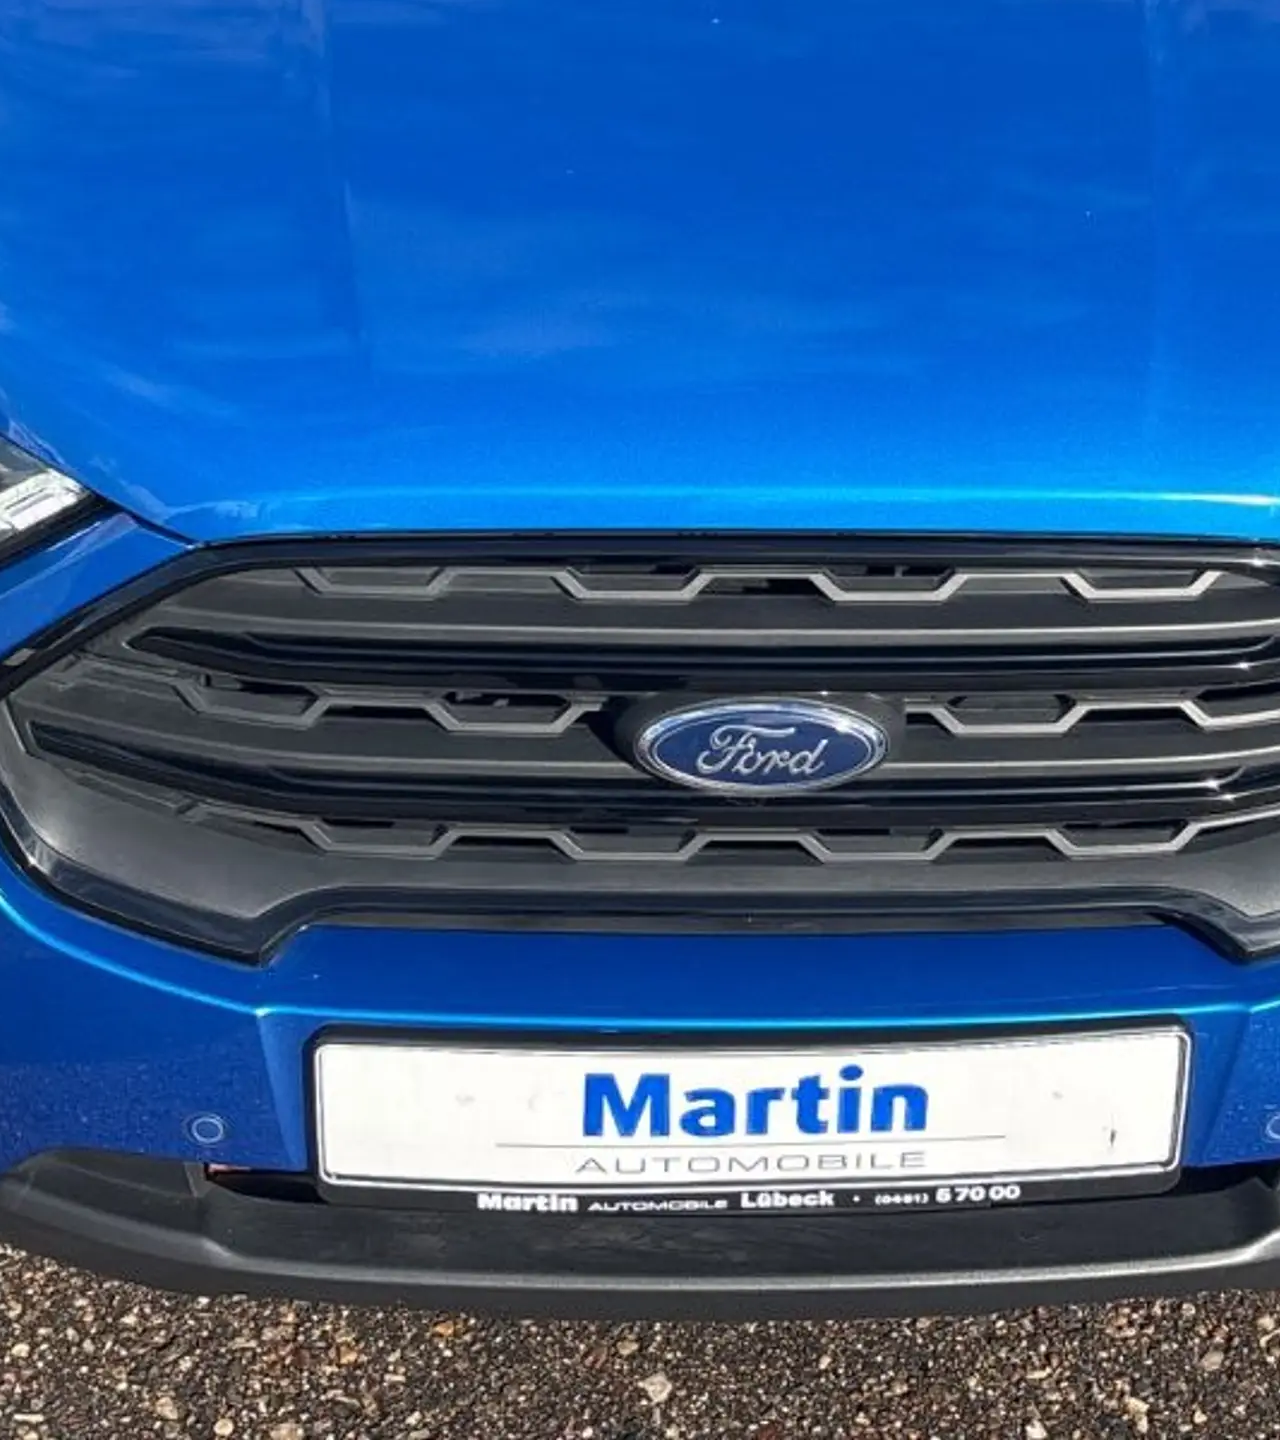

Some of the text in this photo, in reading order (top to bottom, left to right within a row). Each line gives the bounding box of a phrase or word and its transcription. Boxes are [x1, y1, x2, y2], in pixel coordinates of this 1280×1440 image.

[695, 724, 829, 776] Ford
[582, 1063, 929, 1138] Martin
[575, 1151, 927, 1175] AUTOMOBILE
[477, 1192, 579, 1213] Martin
[588, 1199, 729, 1212] AUTOMOBILE
[740, 1189, 836, 1209] Lübeck
